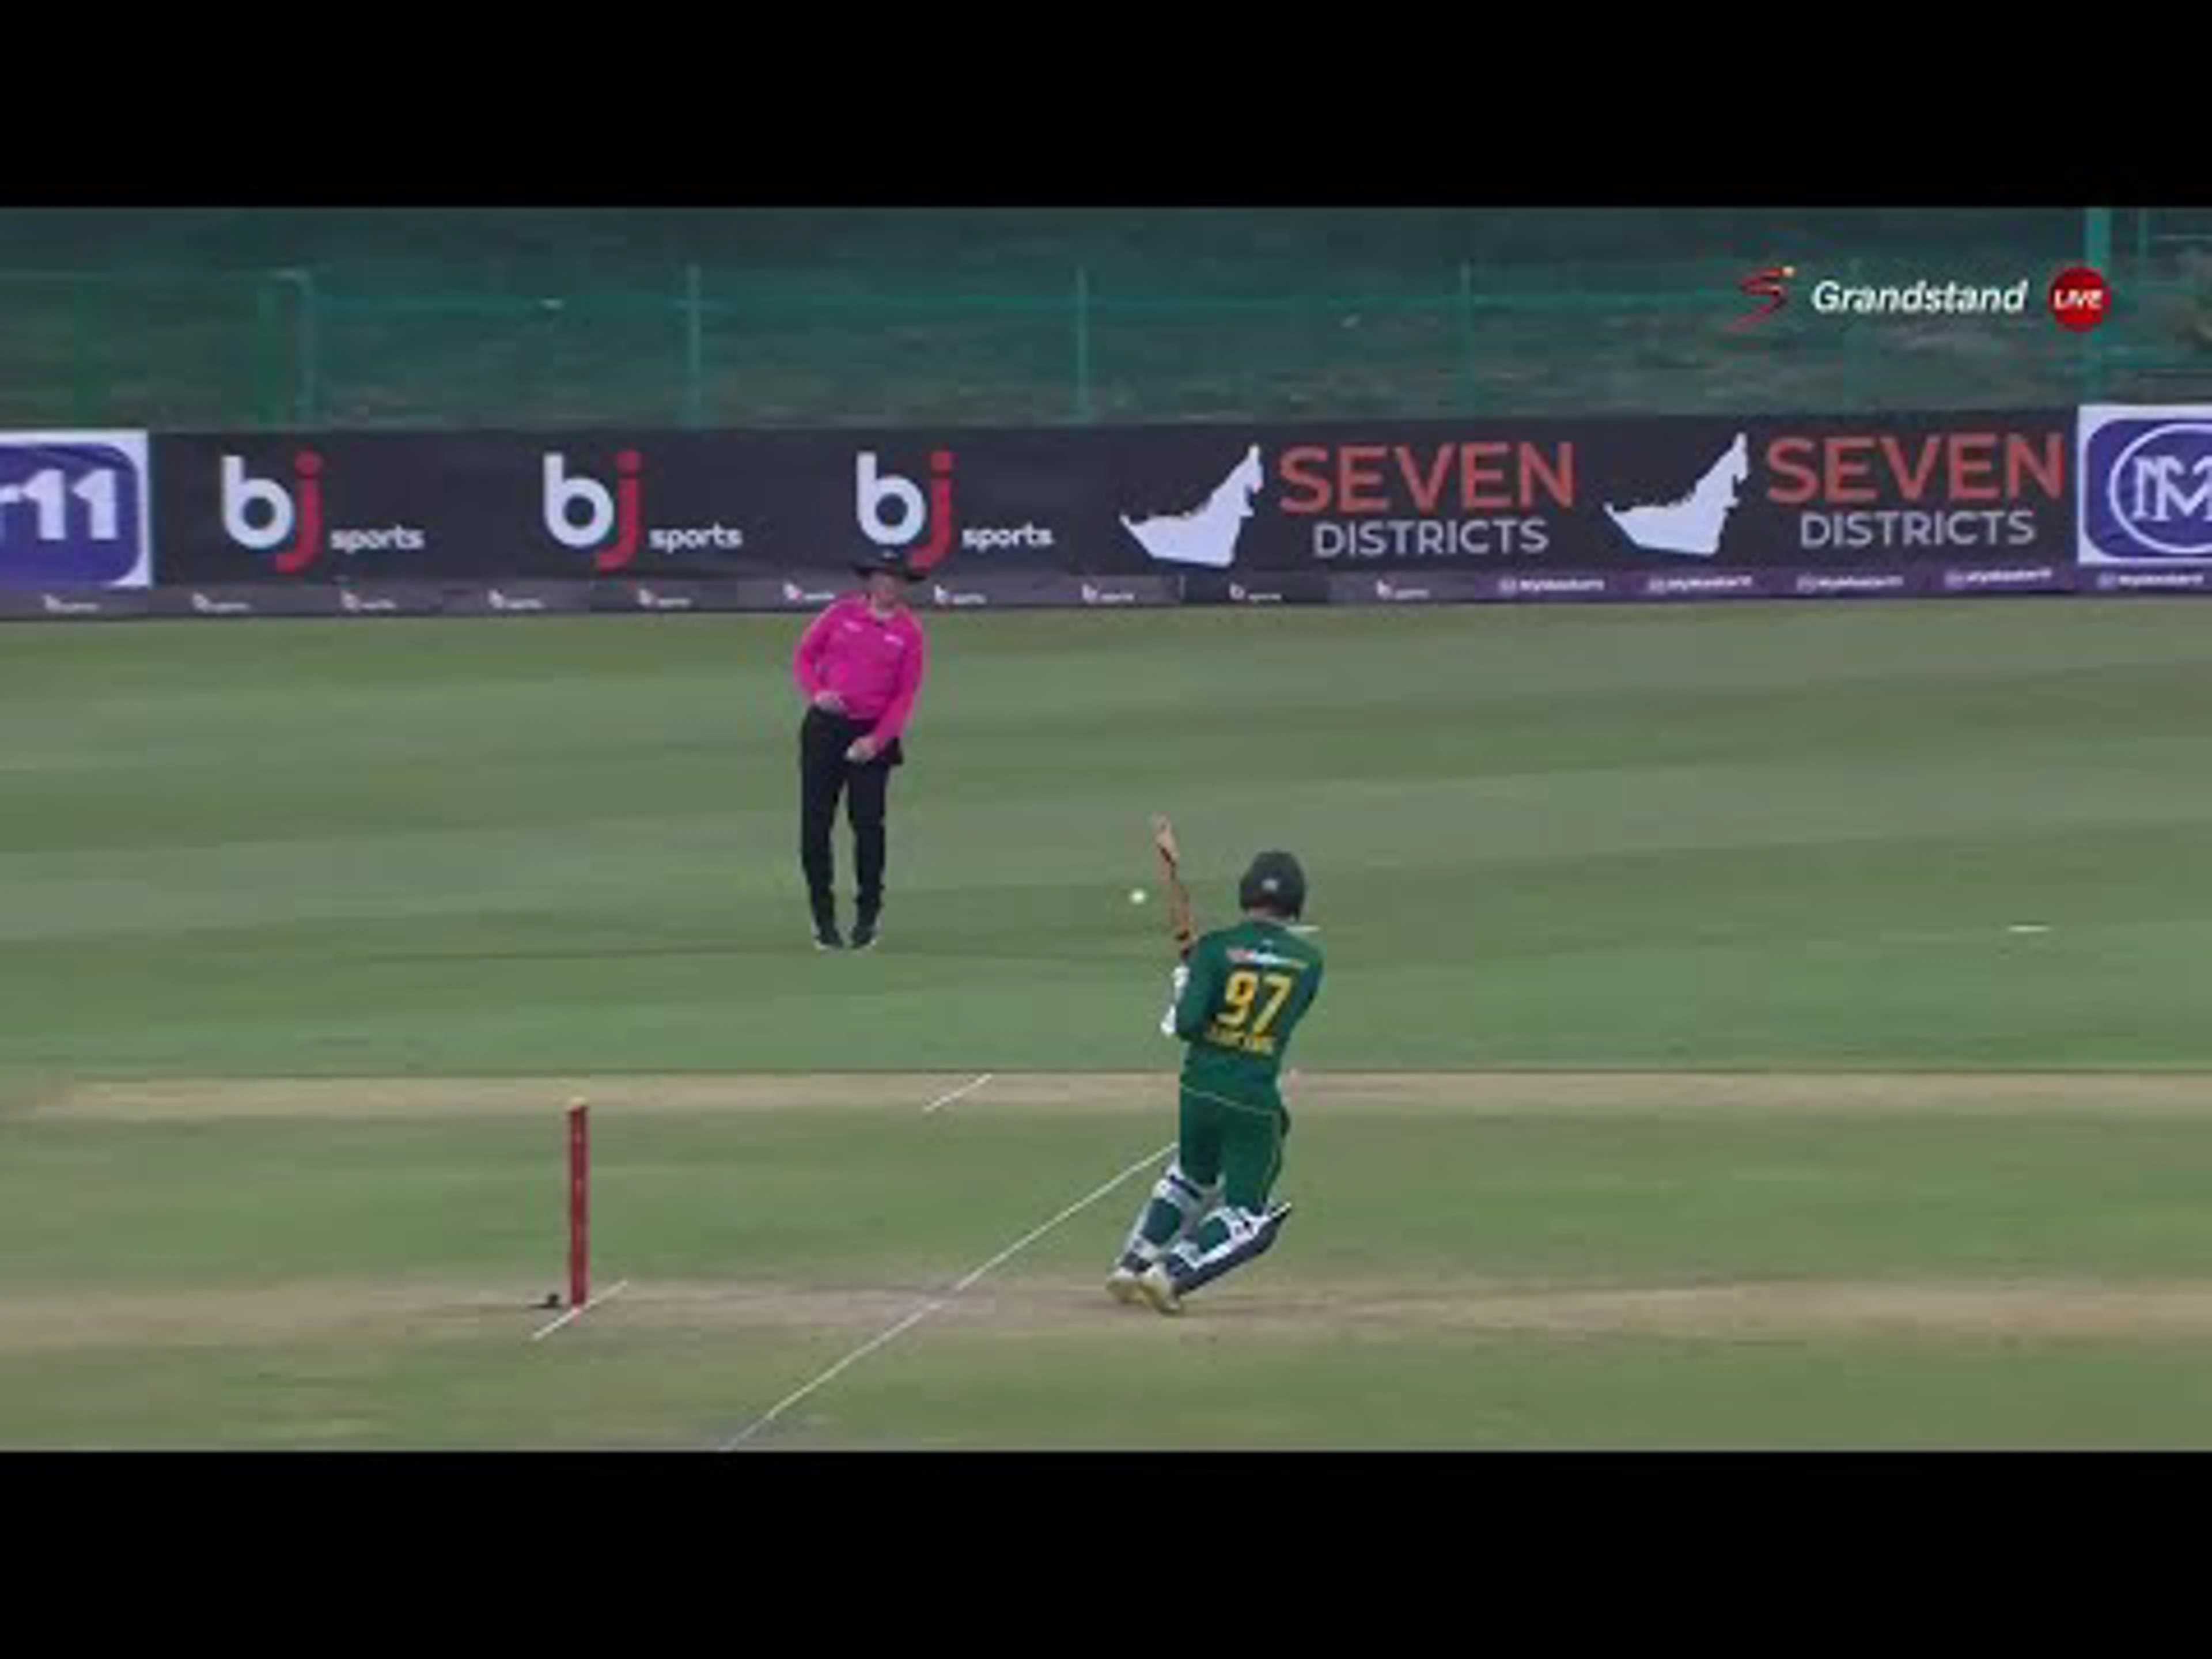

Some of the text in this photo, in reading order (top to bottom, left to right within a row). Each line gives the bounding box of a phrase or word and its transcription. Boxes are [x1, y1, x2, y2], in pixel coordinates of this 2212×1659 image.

[1279, 441, 1576, 514] SEVEN
[1768, 433, 2065, 503] SEVEN
[222, 451, 425, 573] bj sports
[543, 450, 743, 572] bj sports
[856, 451, 1055, 571] bj sports
[1312, 517, 1550, 558] DISTRICTS
[1800, 509, 2037, 548] DISTRICTS
[1215, 971, 1292, 1036] 97
